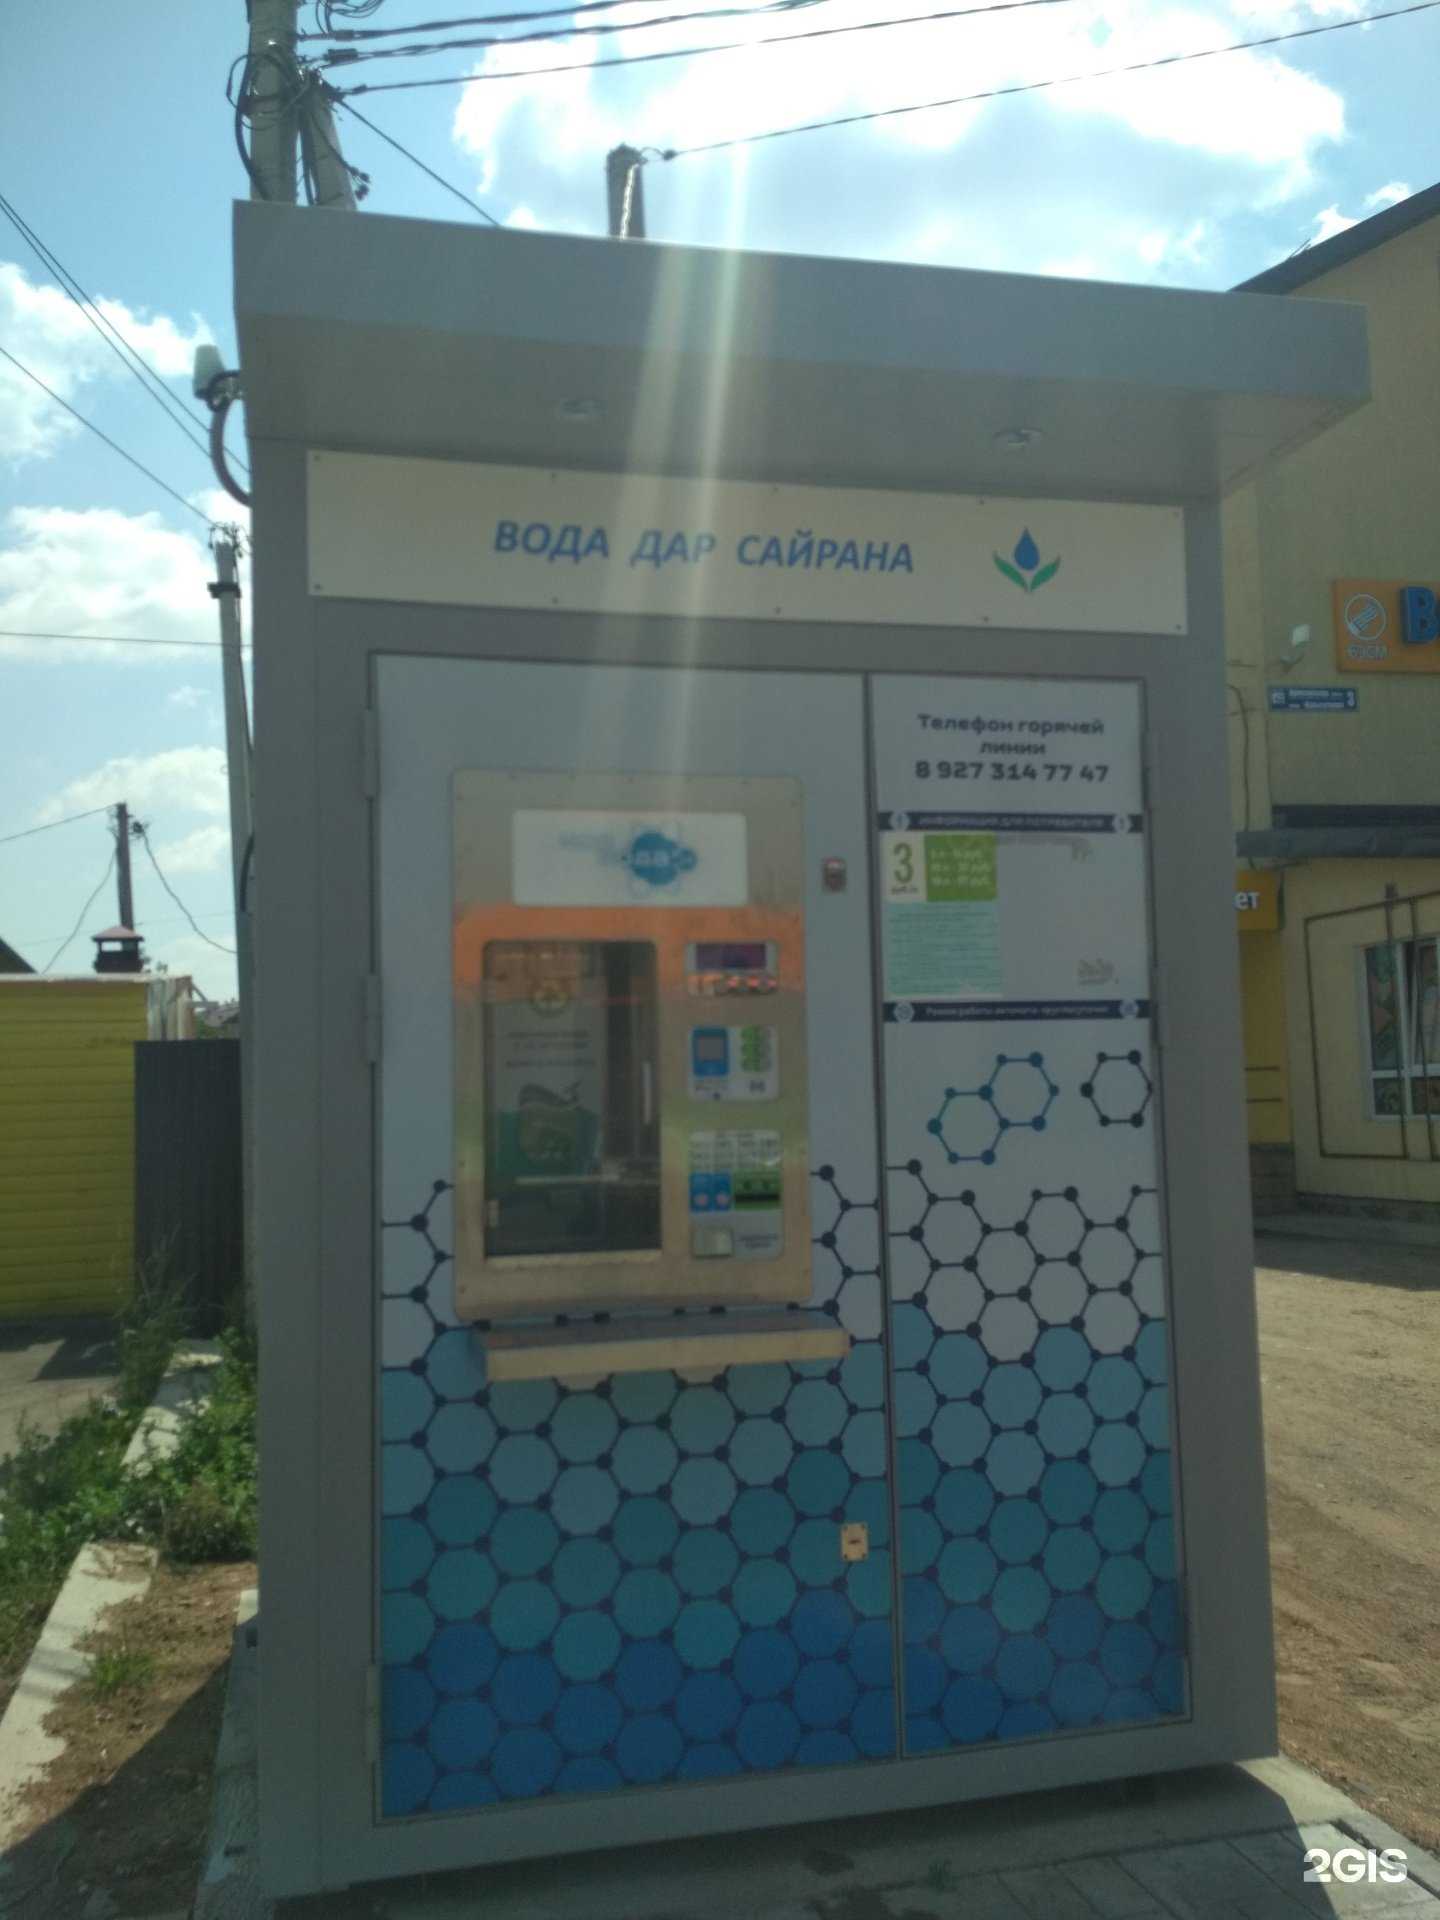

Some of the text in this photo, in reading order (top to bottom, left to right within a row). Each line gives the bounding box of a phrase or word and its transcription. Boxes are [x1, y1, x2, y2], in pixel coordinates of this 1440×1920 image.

[494, 520, 914, 573] ВОДА ДАР САЙРАНА
[918, 714, 1104, 737] Телефон горячей
[980, 741, 1046, 755] линии
[915, 761, 1109, 782] 8 927 314 77 47
[893, 843, 914, 883] 3
